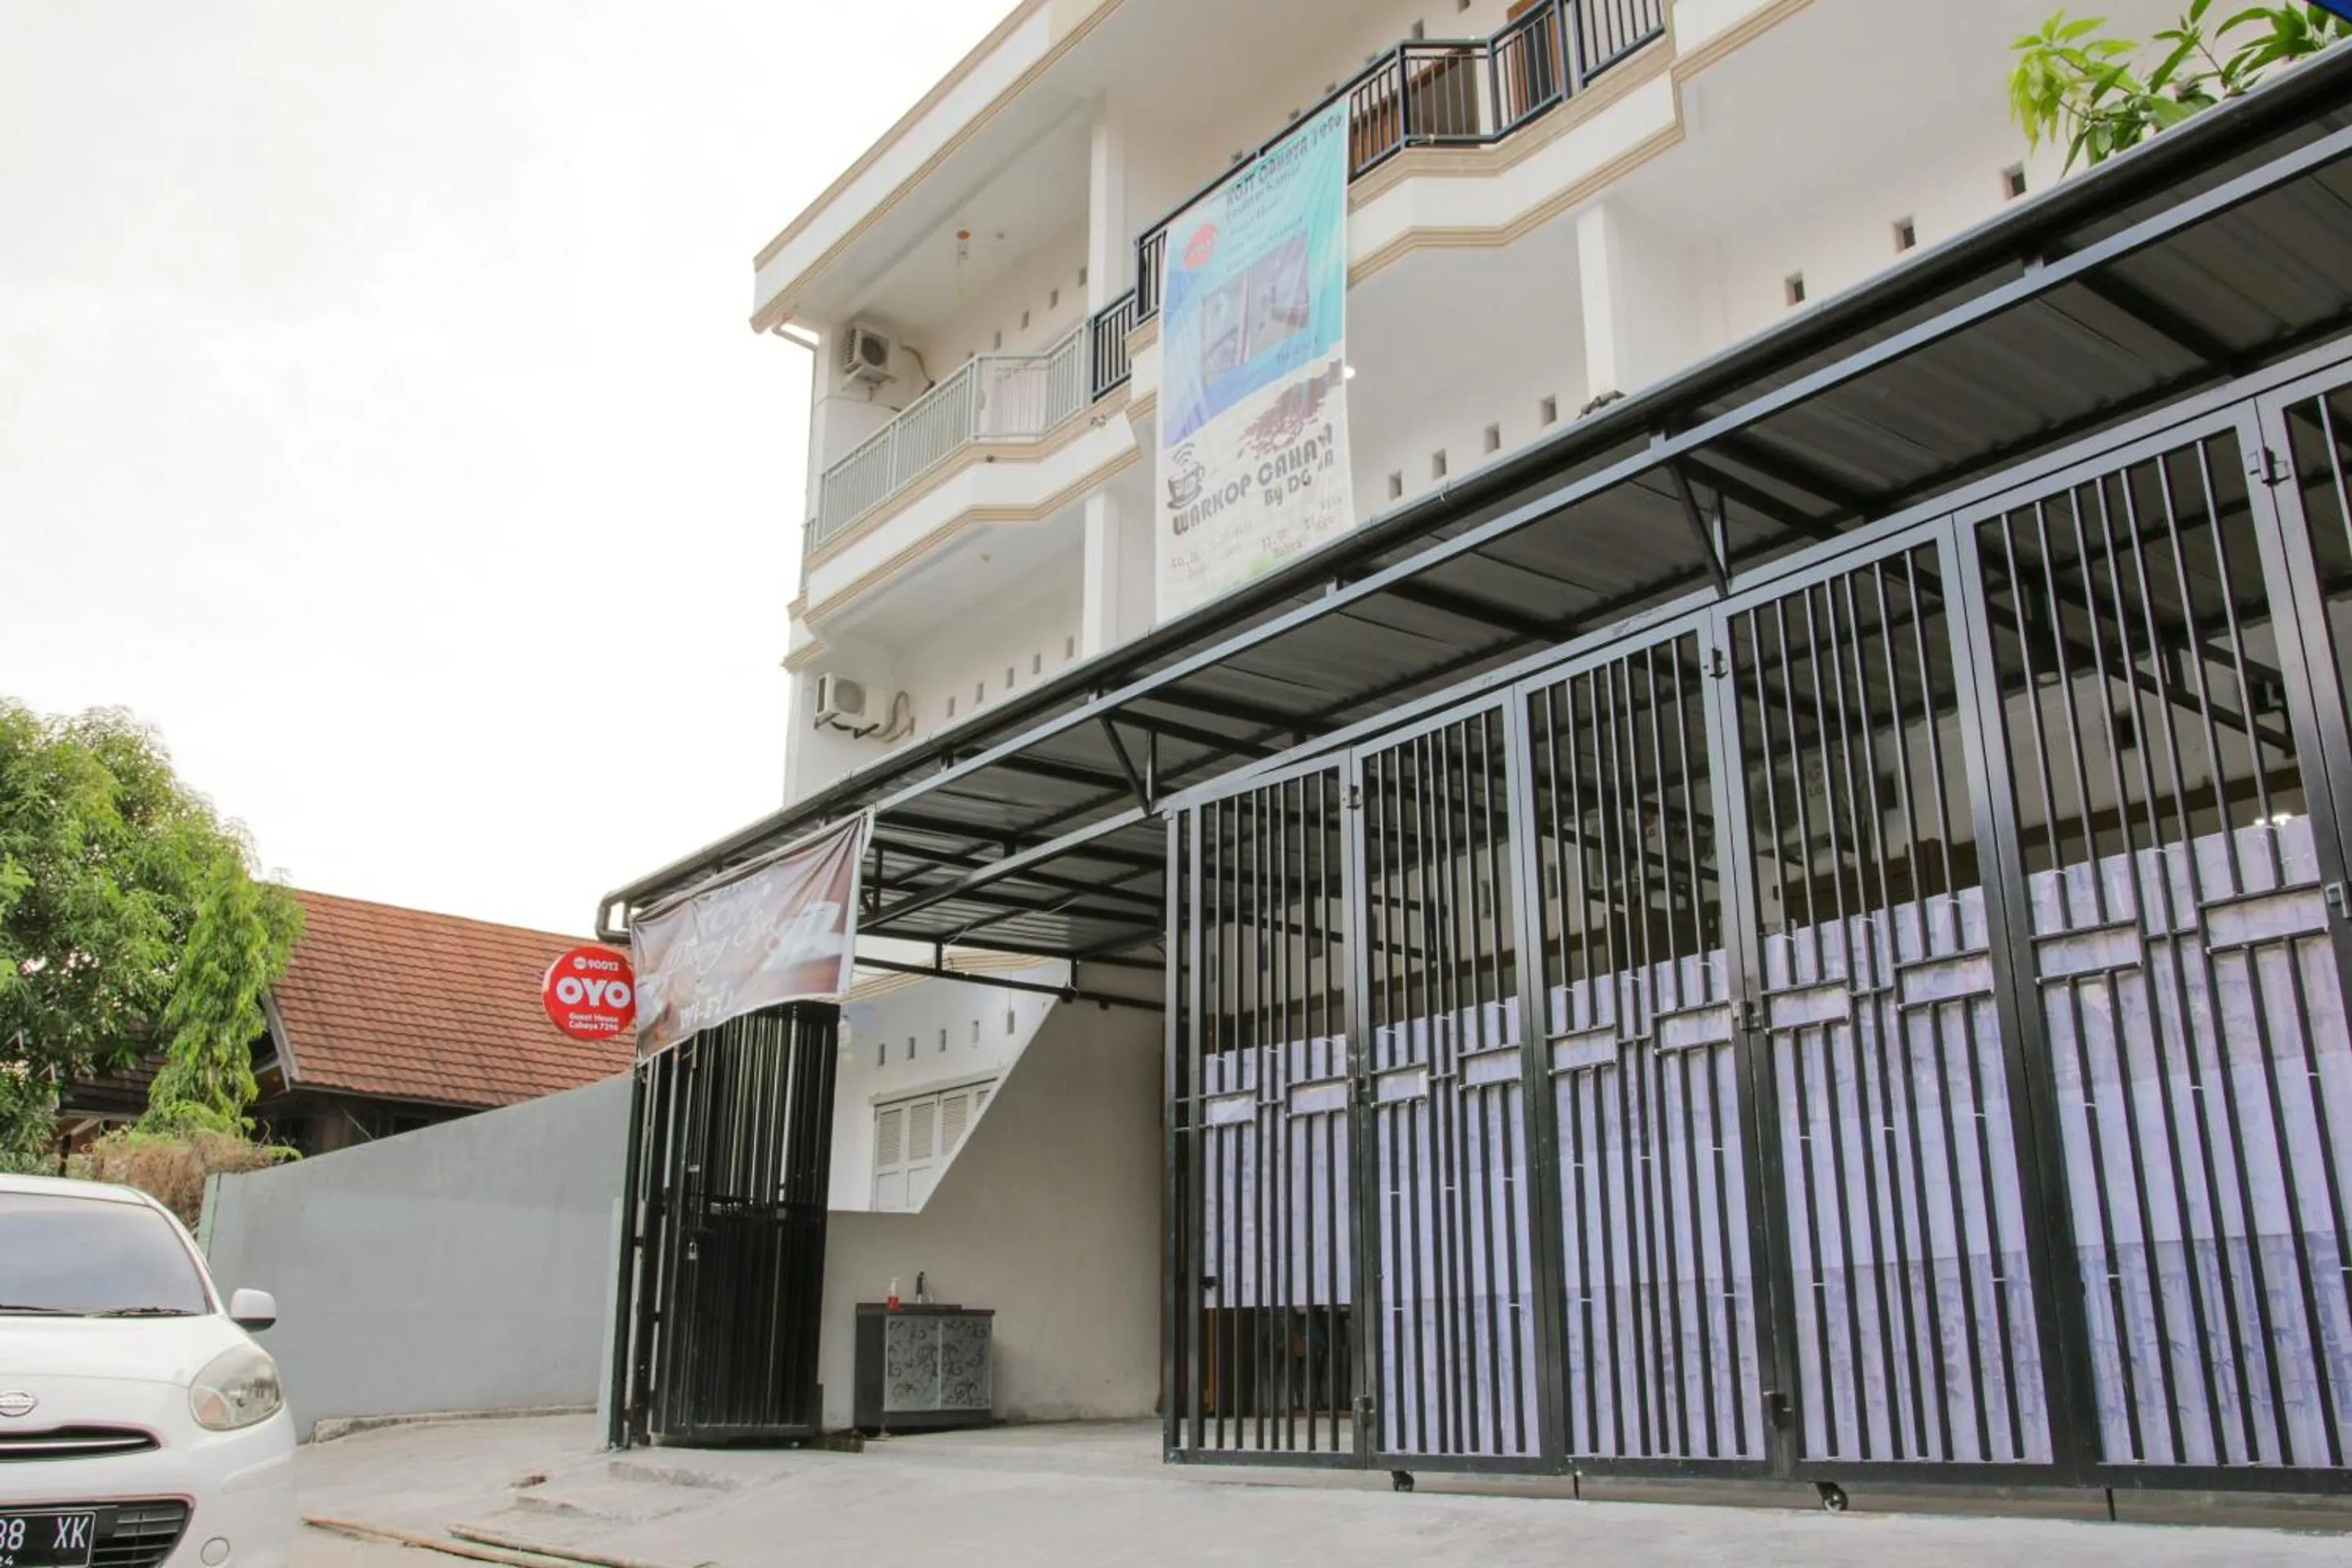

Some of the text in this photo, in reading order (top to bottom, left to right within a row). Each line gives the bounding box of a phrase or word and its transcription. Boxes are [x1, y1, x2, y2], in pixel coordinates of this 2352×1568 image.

[1173, 474, 1252, 536] WARKOP
[1264, 487, 1283, 506] By
[556, 976, 631, 1009] OYO
[52, 1516, 89, 1549] XK
